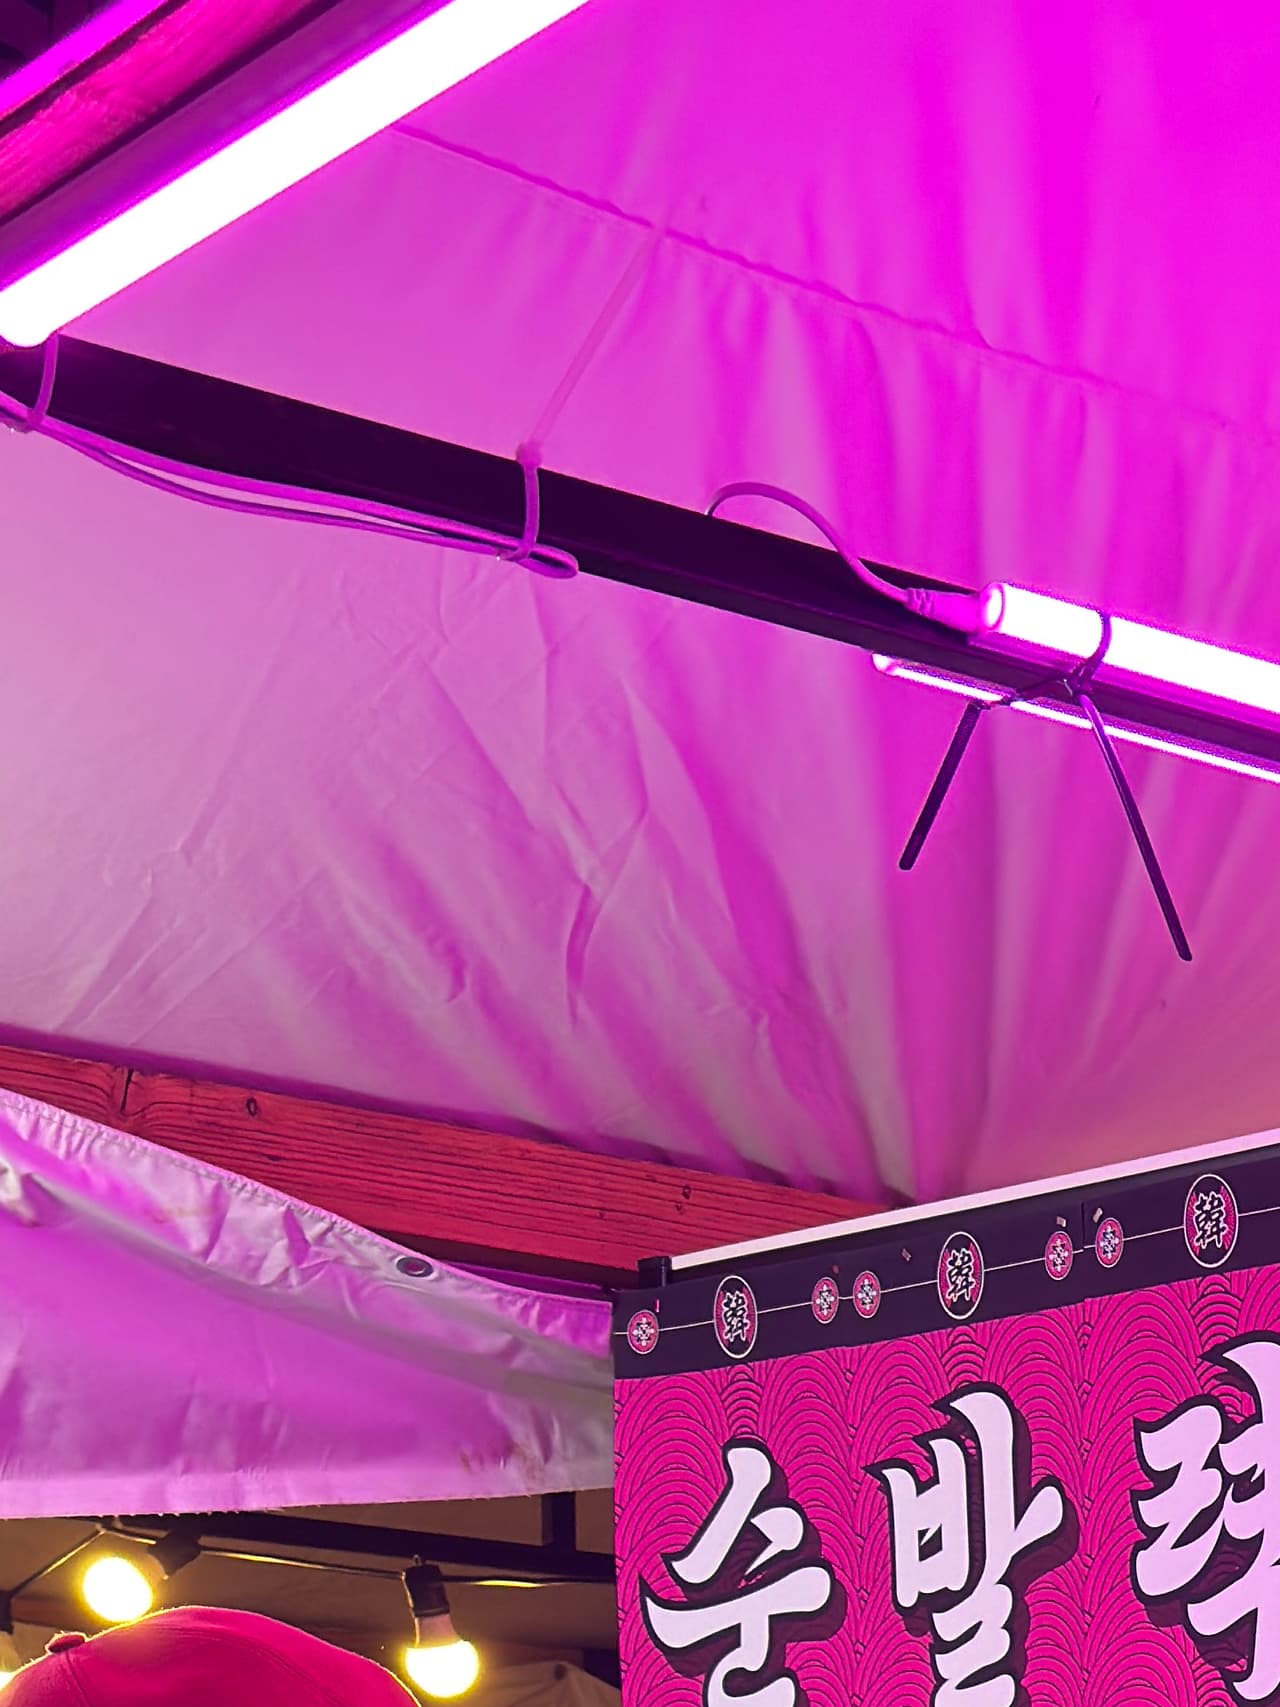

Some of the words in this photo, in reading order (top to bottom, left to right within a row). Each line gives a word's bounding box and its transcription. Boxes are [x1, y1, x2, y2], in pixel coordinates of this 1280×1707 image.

[1195, 1192, 1228, 1253] 韓
[945, 1248, 978, 1305] 韓
[721, 1292, 753, 1346] 韓
